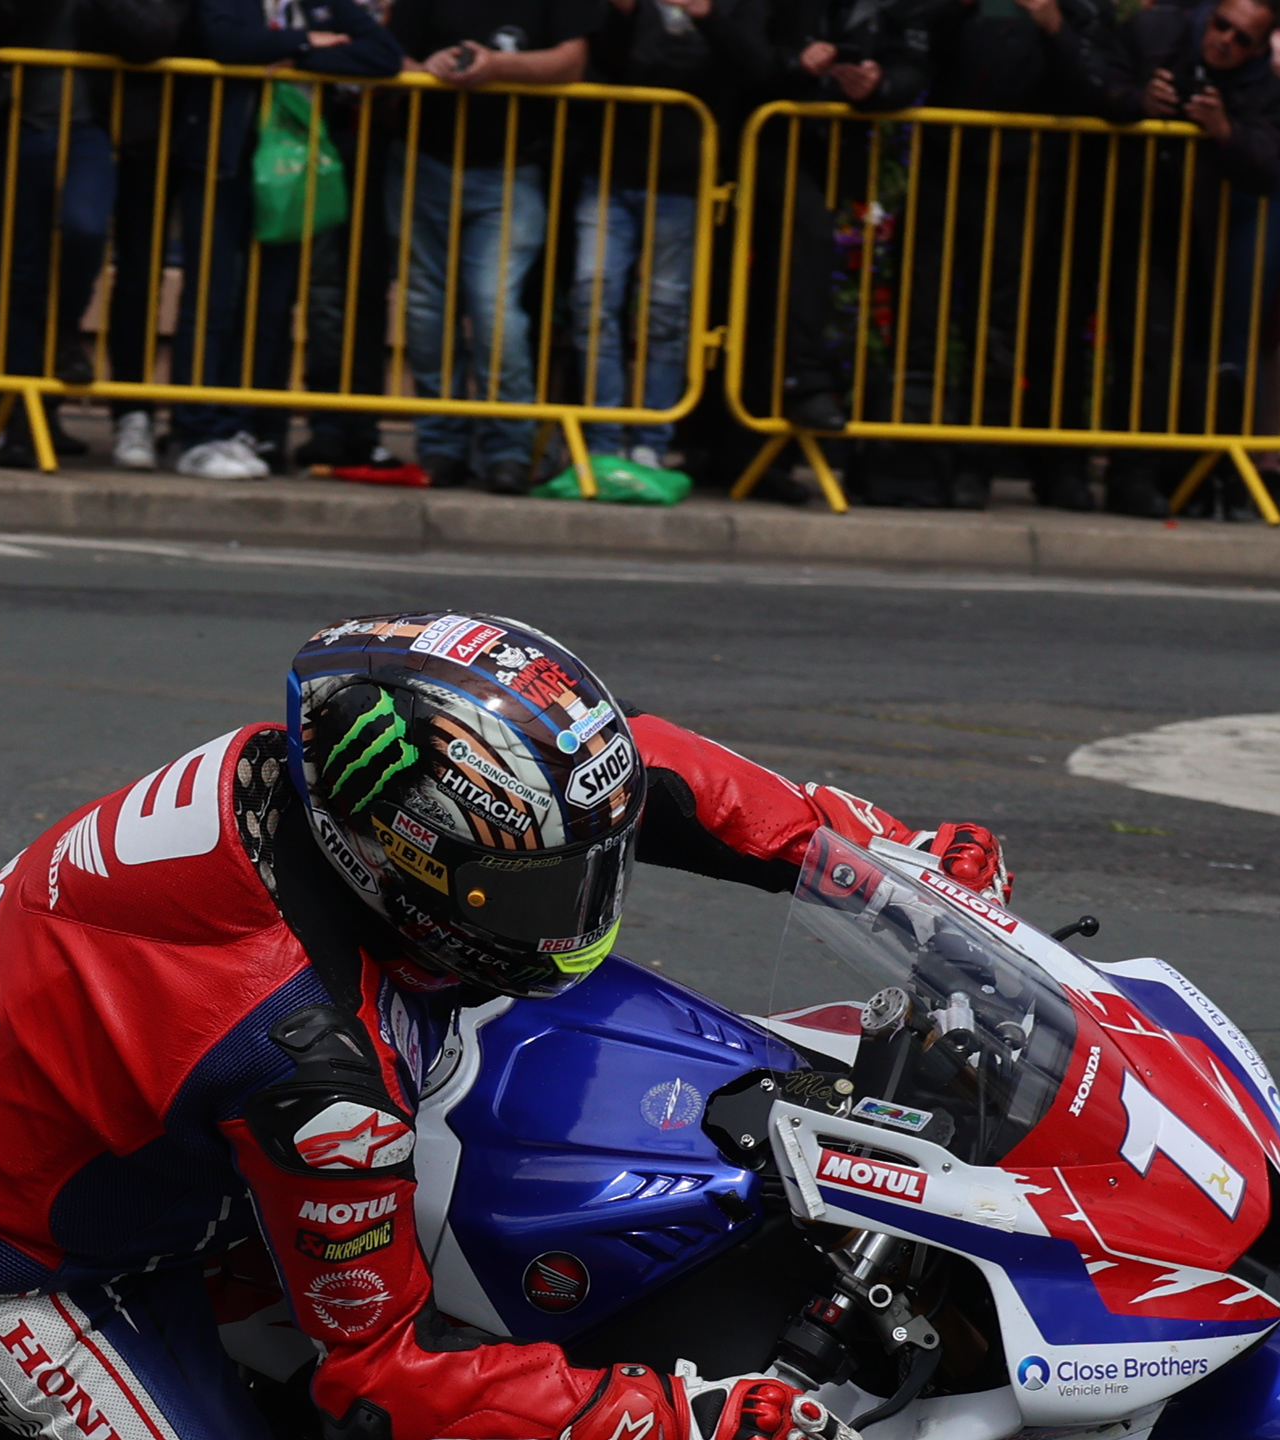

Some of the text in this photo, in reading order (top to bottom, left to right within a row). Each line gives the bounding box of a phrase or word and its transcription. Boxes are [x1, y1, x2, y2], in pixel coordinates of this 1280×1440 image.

[509, 657, 559, 691] VAMPIRE
[520, 665, 578, 708] VAPE
[466, 754, 550, 808] CASINOCOIN.IM
[579, 743, 630, 799] SHOEI
[437, 783, 486, 818] CONSTRUCTION
[486, 812, 523, 837] MACHINERY
[441, 768, 532, 832] HITACHI
[321, 819, 371, 887] SHOEI
[394, 825, 431, 852] SPARK PLUGS
[397, 814, 437, 846] NGK
[49, 830, 69, 910] ONDA
[927, 873, 1016, 931] MOTUL
[396, 894, 510, 971] MONSTER
[541, 923, 610, 951] RED TORP
[1153, 958, 1227, 1026] Brothers
[1227, 1029, 1268, 1080] Close
[1068, 1045, 1101, 1117] HONDA
[1119, 1067, 1247, 1222] 1
[821, 1155, 920, 1198] MOTUL
[298, 1192, 397, 1224] MOTUL
[531, 1290, 577, 1300] HONDA
[1056, 1355, 1208, 1383] Close Brothers
[1058, 1383, 1129, 1396] Vehicle Hire
